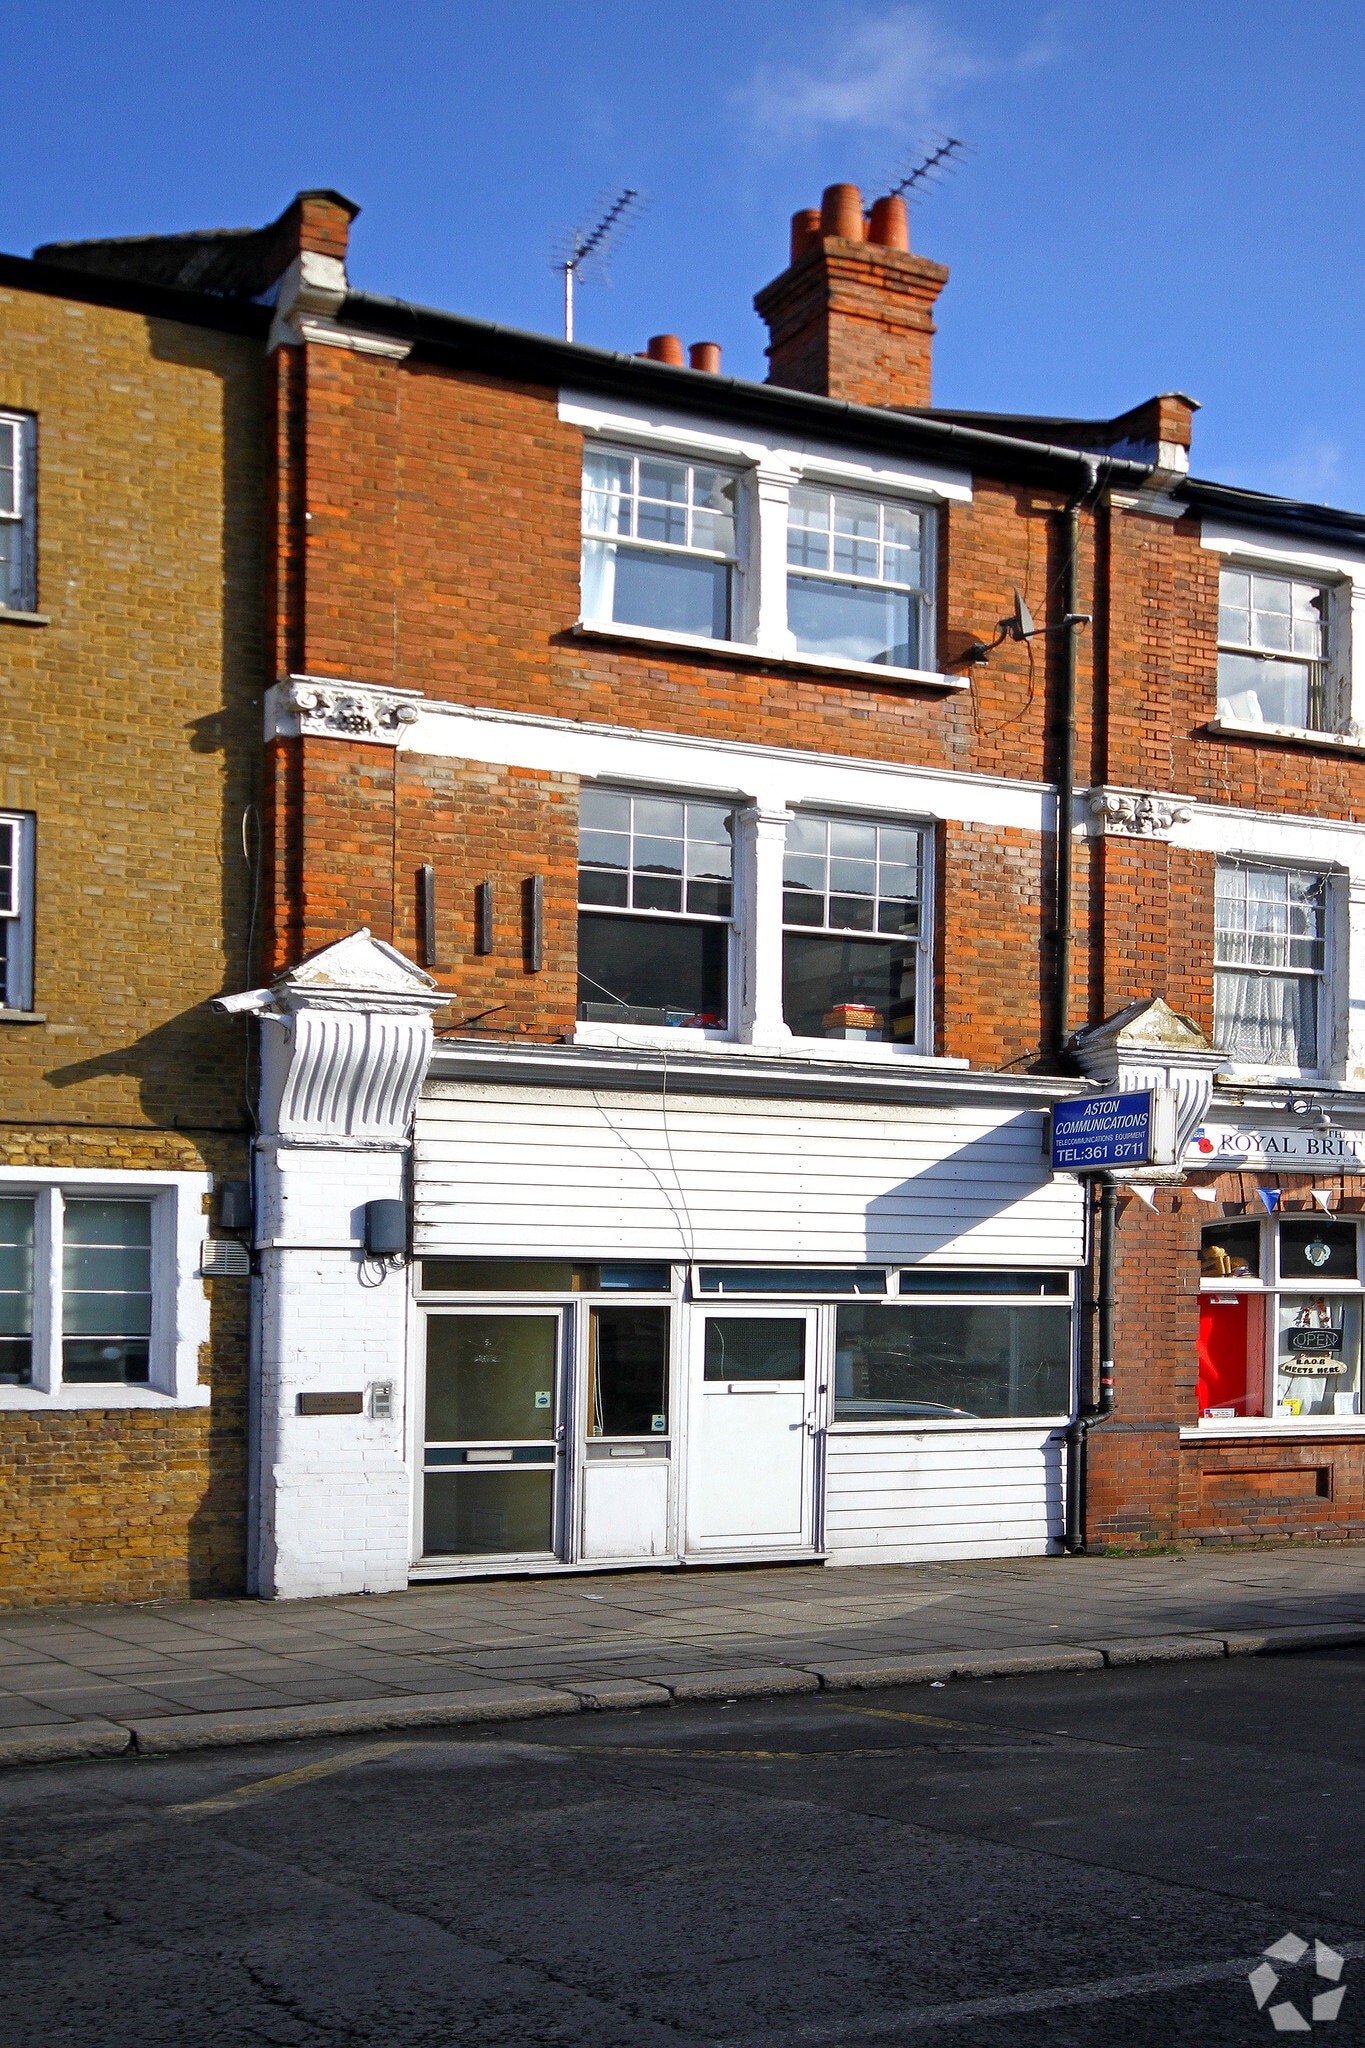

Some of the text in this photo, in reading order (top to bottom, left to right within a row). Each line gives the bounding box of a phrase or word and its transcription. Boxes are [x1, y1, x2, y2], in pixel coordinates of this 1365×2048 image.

[1083, 1100, 1121, 1116] ASTON
[1055, 1113, 1149, 1135] COMMUNICATIONS
[1056, 1131, 1146, 1146] TELECOMMUNICATIONS EQUIPMENT
[1328, 1130, 1348, 1139] THE
[1221, 1134, 1297, 1154] ROYAL
[1057, 1142, 1144, 1162] TEL:361 8711
[1296, 1333, 1335, 1346] OPEN
[1284, 1365, 1314, 1373] MEETS
